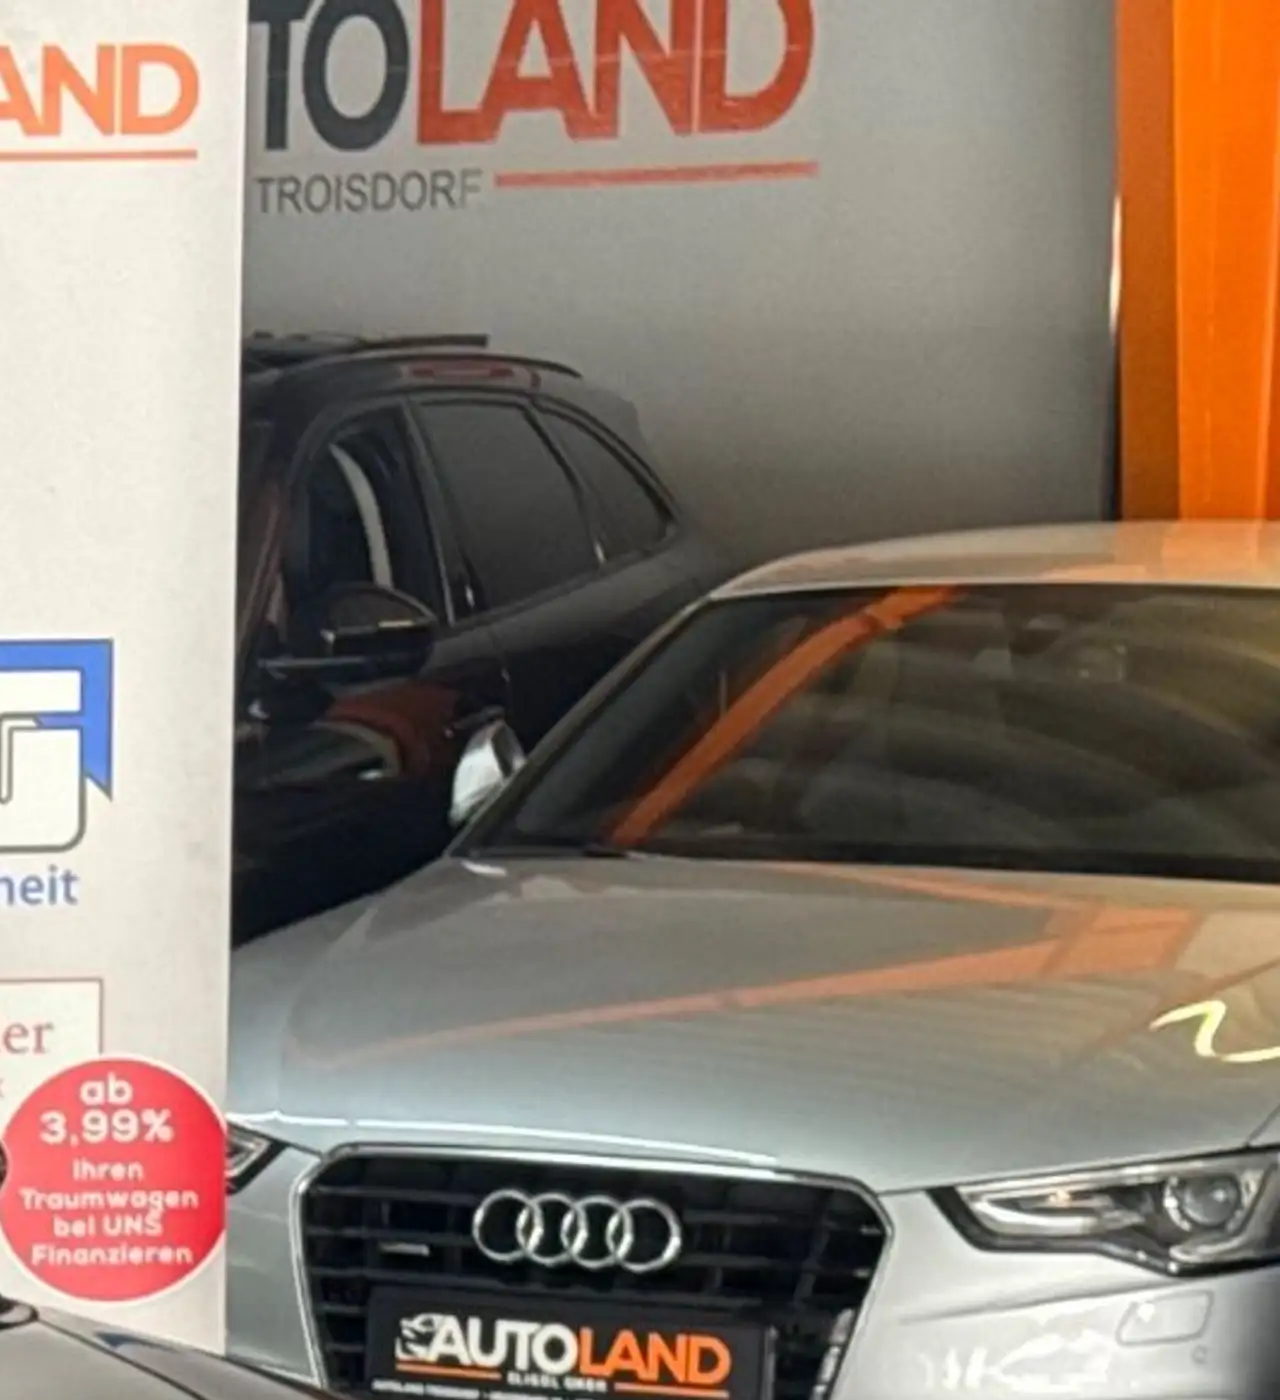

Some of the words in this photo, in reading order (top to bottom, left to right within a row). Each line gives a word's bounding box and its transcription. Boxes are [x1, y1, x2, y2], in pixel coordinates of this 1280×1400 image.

[247, 0, 815, 151] TOLAND
[255, 168, 483, 214] TROISDORF
[79, 1071, 134, 1106] ab
[72, 1158, 145, 1182] Ihren
[17, 1187, 200, 1216] Traumwagen
[52, 1215, 96, 1238] bei
[102, 1212, 164, 1238] UNS
[30, 1243, 194, 1266] Finanzieren
[428, 1314, 732, 1386] AUTOLAND
